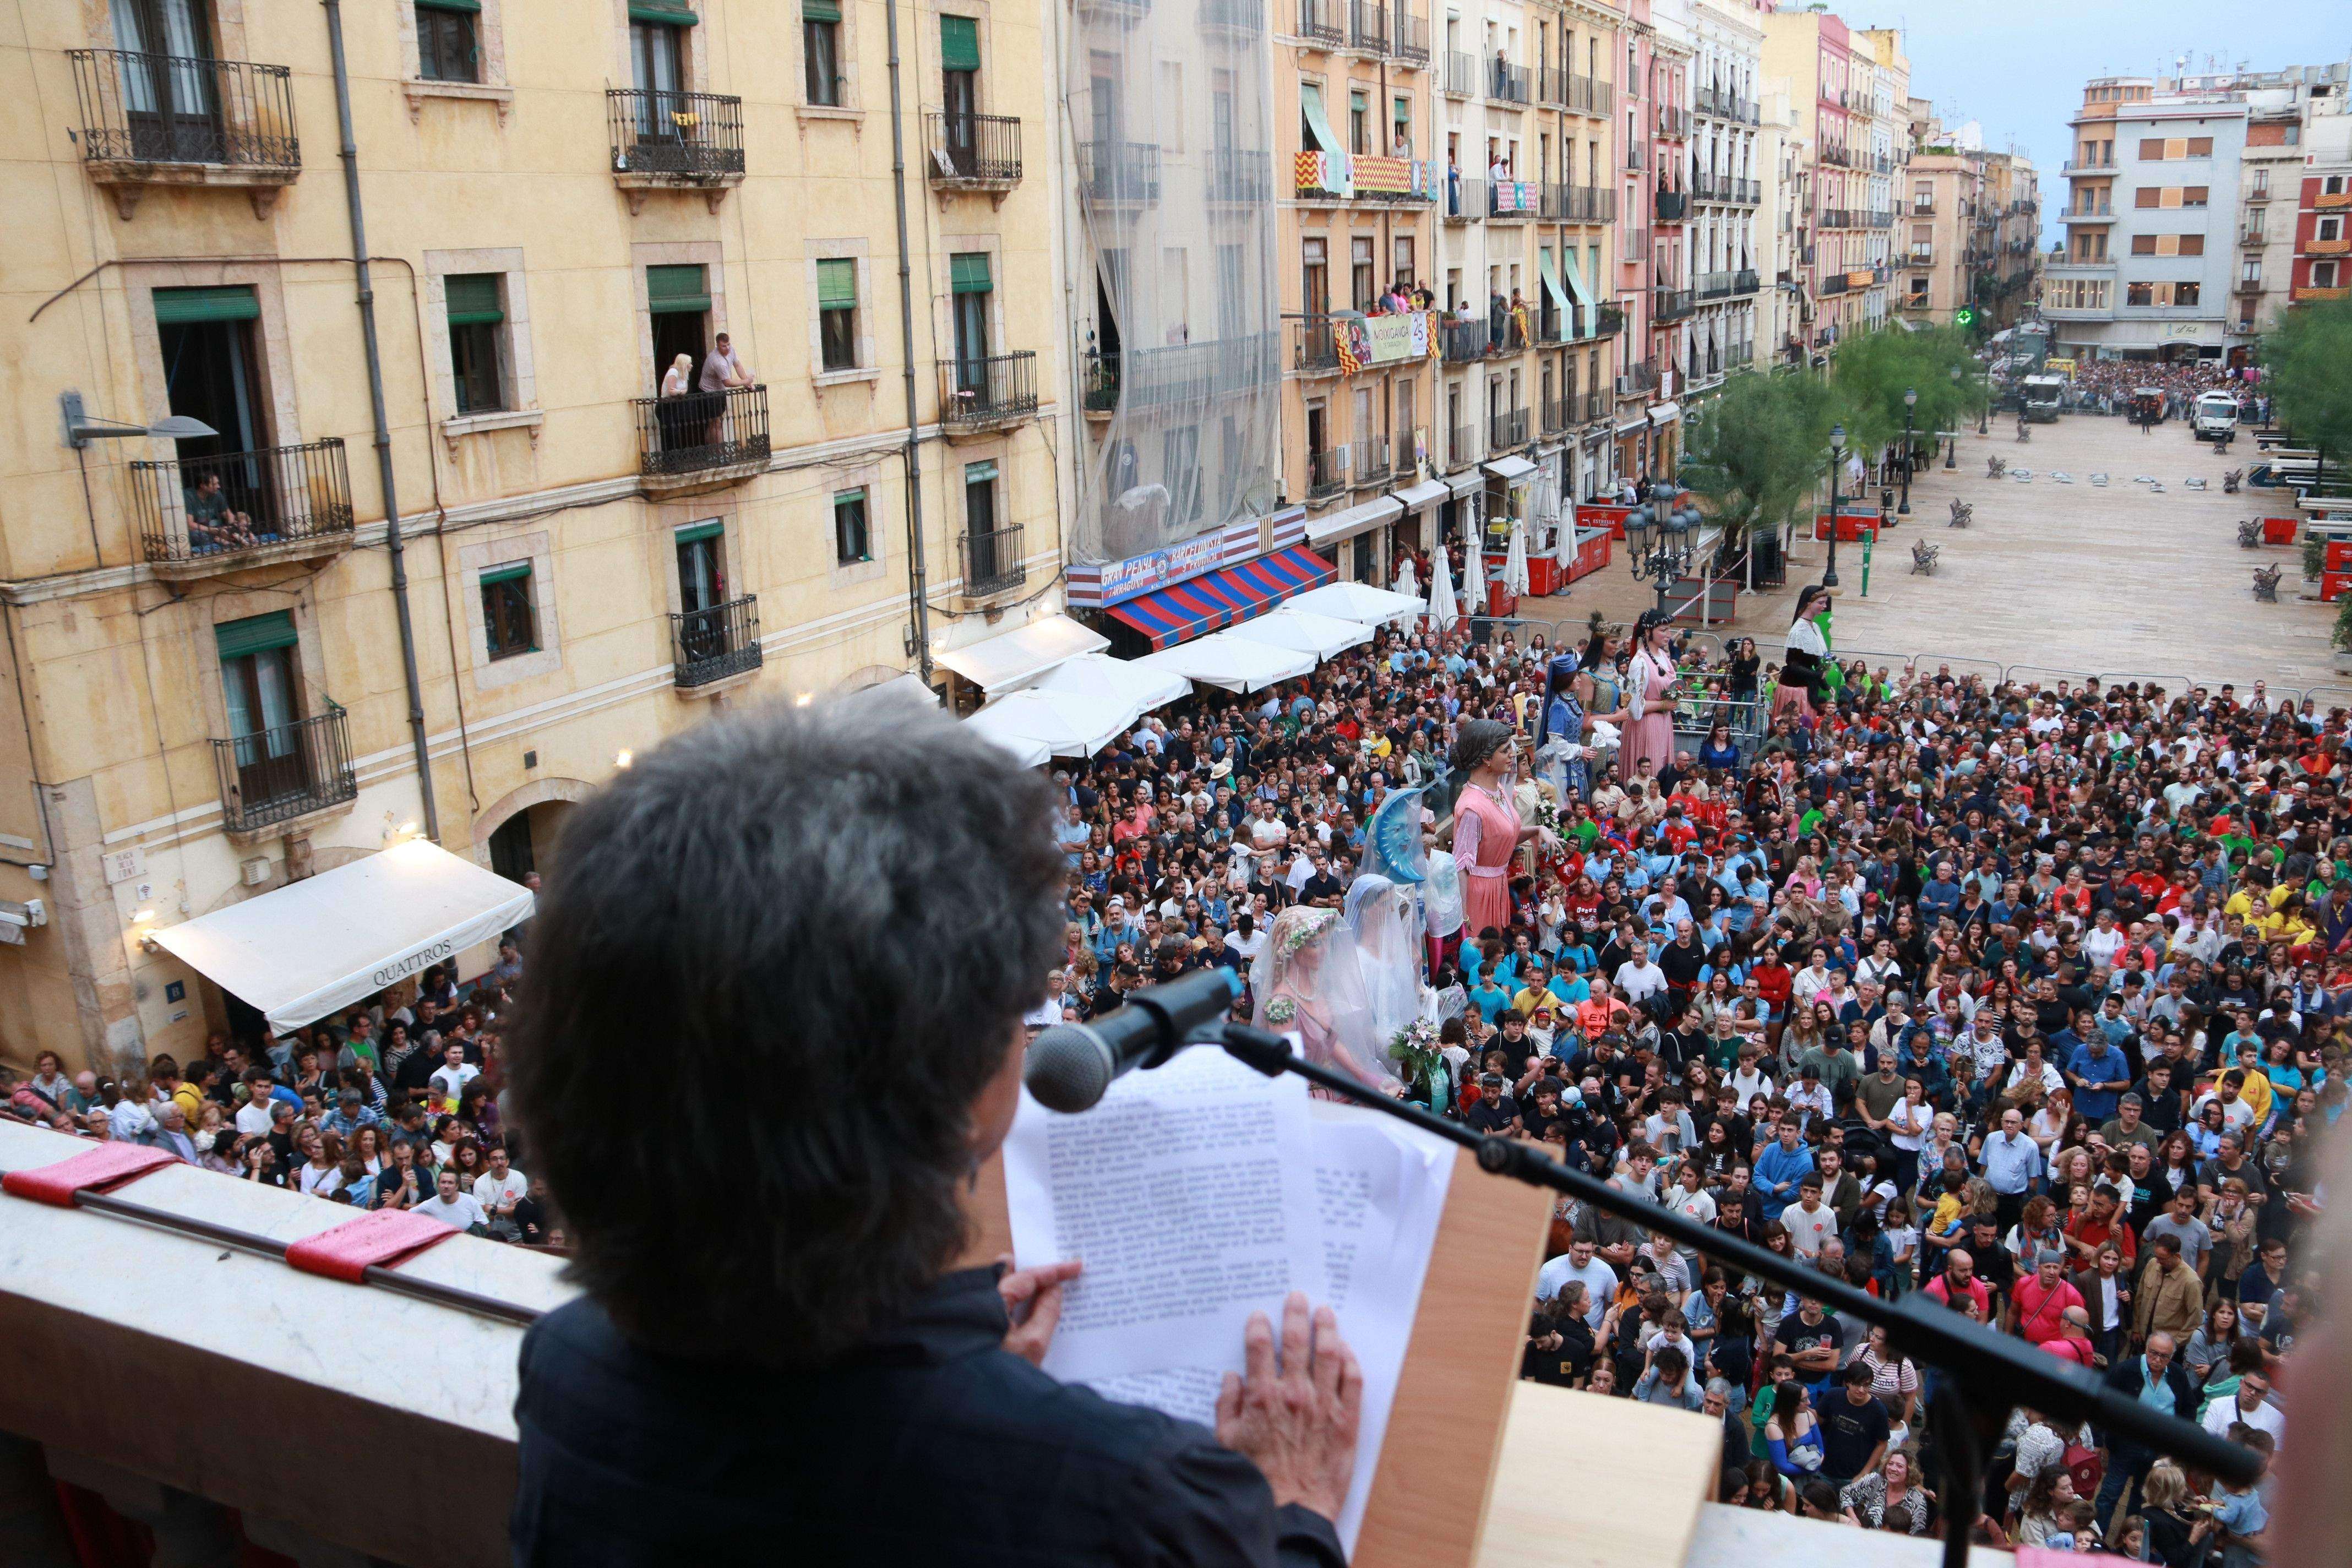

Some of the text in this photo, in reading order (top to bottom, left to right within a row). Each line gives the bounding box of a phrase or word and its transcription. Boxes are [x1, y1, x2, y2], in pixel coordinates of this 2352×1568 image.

[1102, 535, 1221, 586] GRAN PENYA BARCELONISTA
[1109, 579, 1144, 597] TARRAGONA
[1190, 553, 1217, 570] PROVINCIA
[374, 939, 451, 986] QUATTROS
